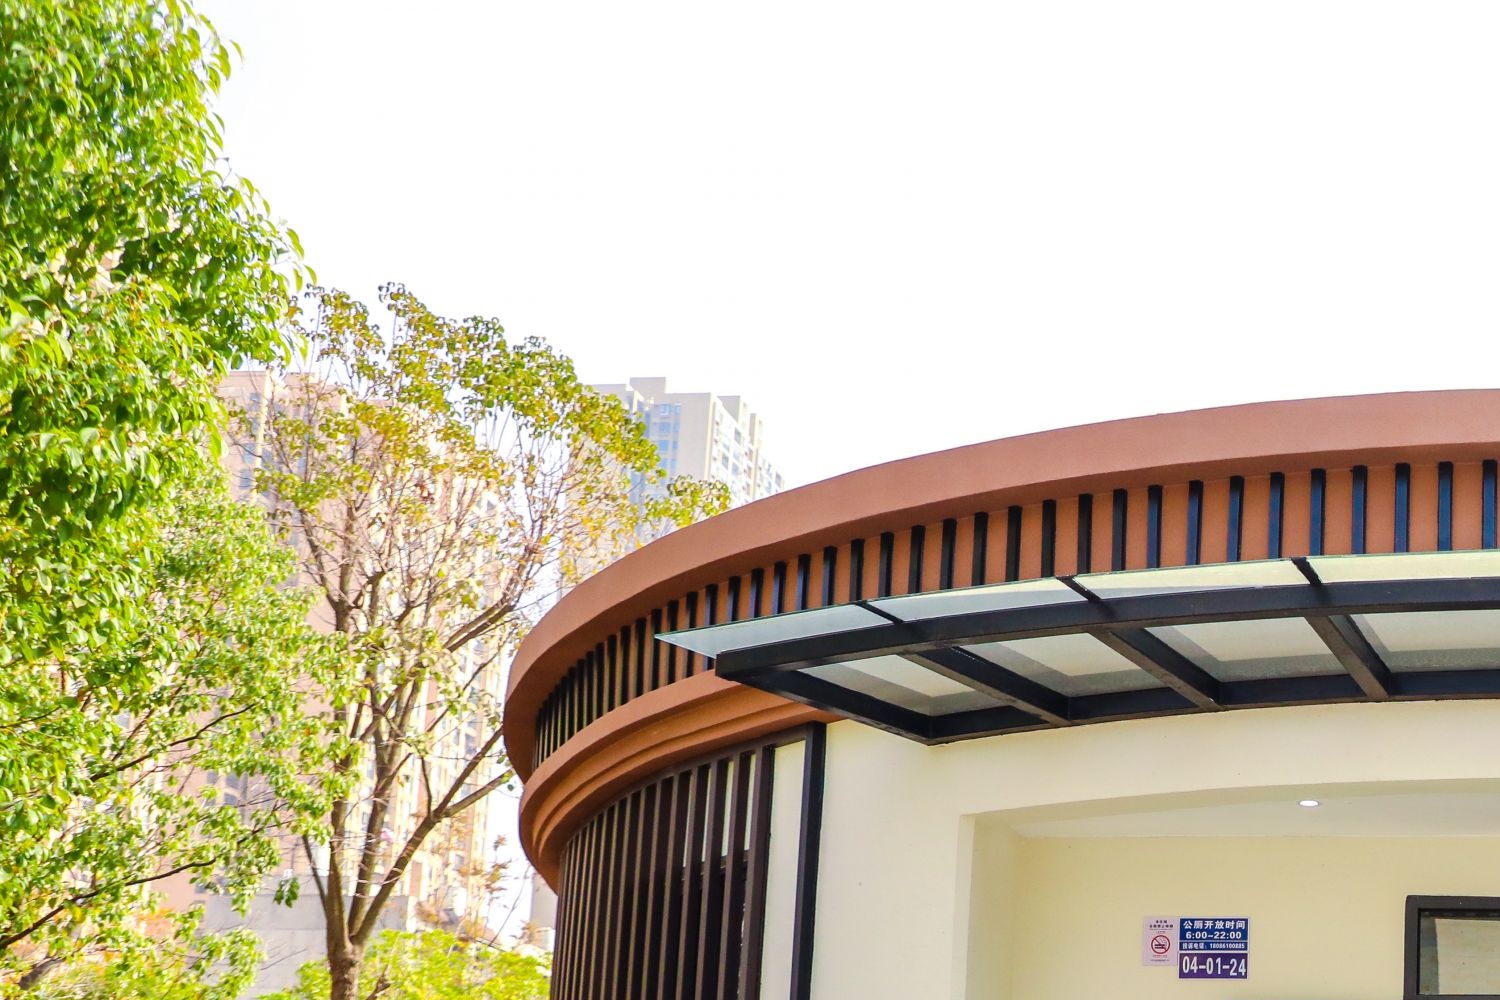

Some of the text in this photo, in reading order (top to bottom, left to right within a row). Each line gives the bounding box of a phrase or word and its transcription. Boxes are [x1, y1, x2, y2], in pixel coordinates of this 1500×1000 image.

[1183, 920, 1246, 929] 公厕开放时间
[1182, 956, 1246, 976] 04-01-24
